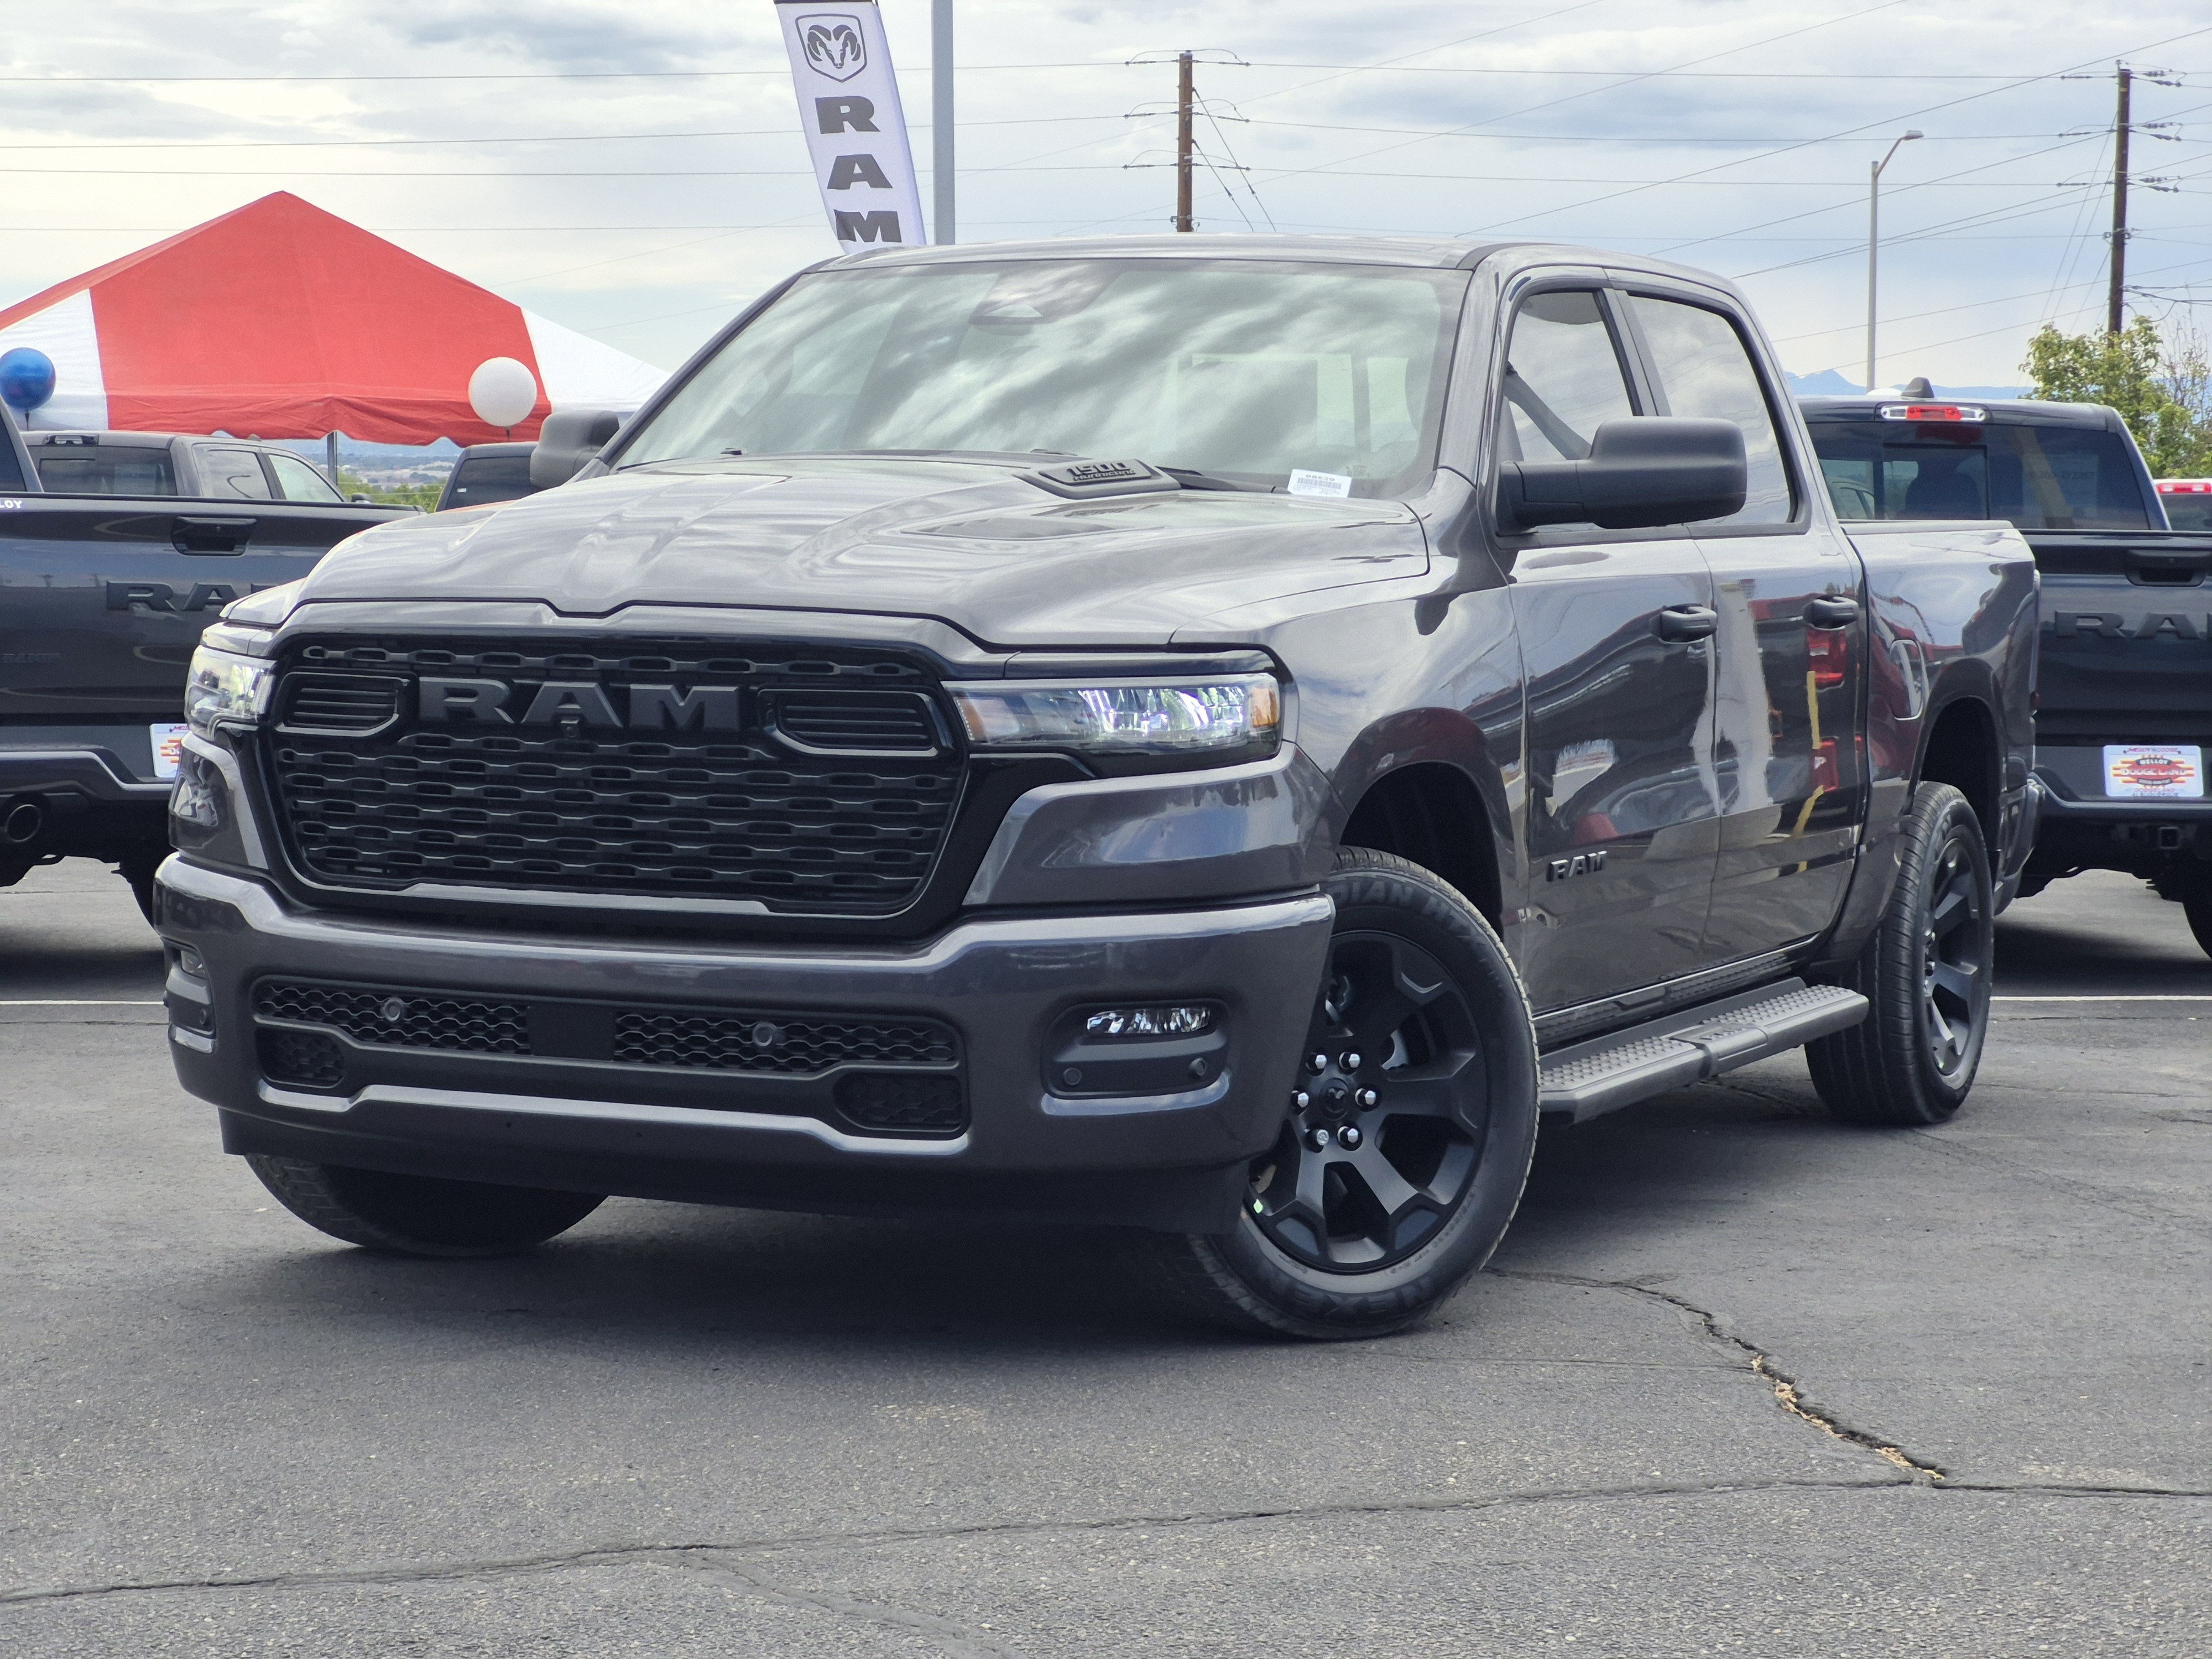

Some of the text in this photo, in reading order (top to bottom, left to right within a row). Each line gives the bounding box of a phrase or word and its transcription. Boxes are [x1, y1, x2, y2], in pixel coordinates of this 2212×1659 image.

[815, 96, 902, 242] RAM
[1067, 462, 1131, 476] 1500
[106, 581, 279, 611] RA
[2054, 611, 2212, 640] RA
[418, 676, 740, 731] RAM
[1546, 851, 1607, 881] RAM
